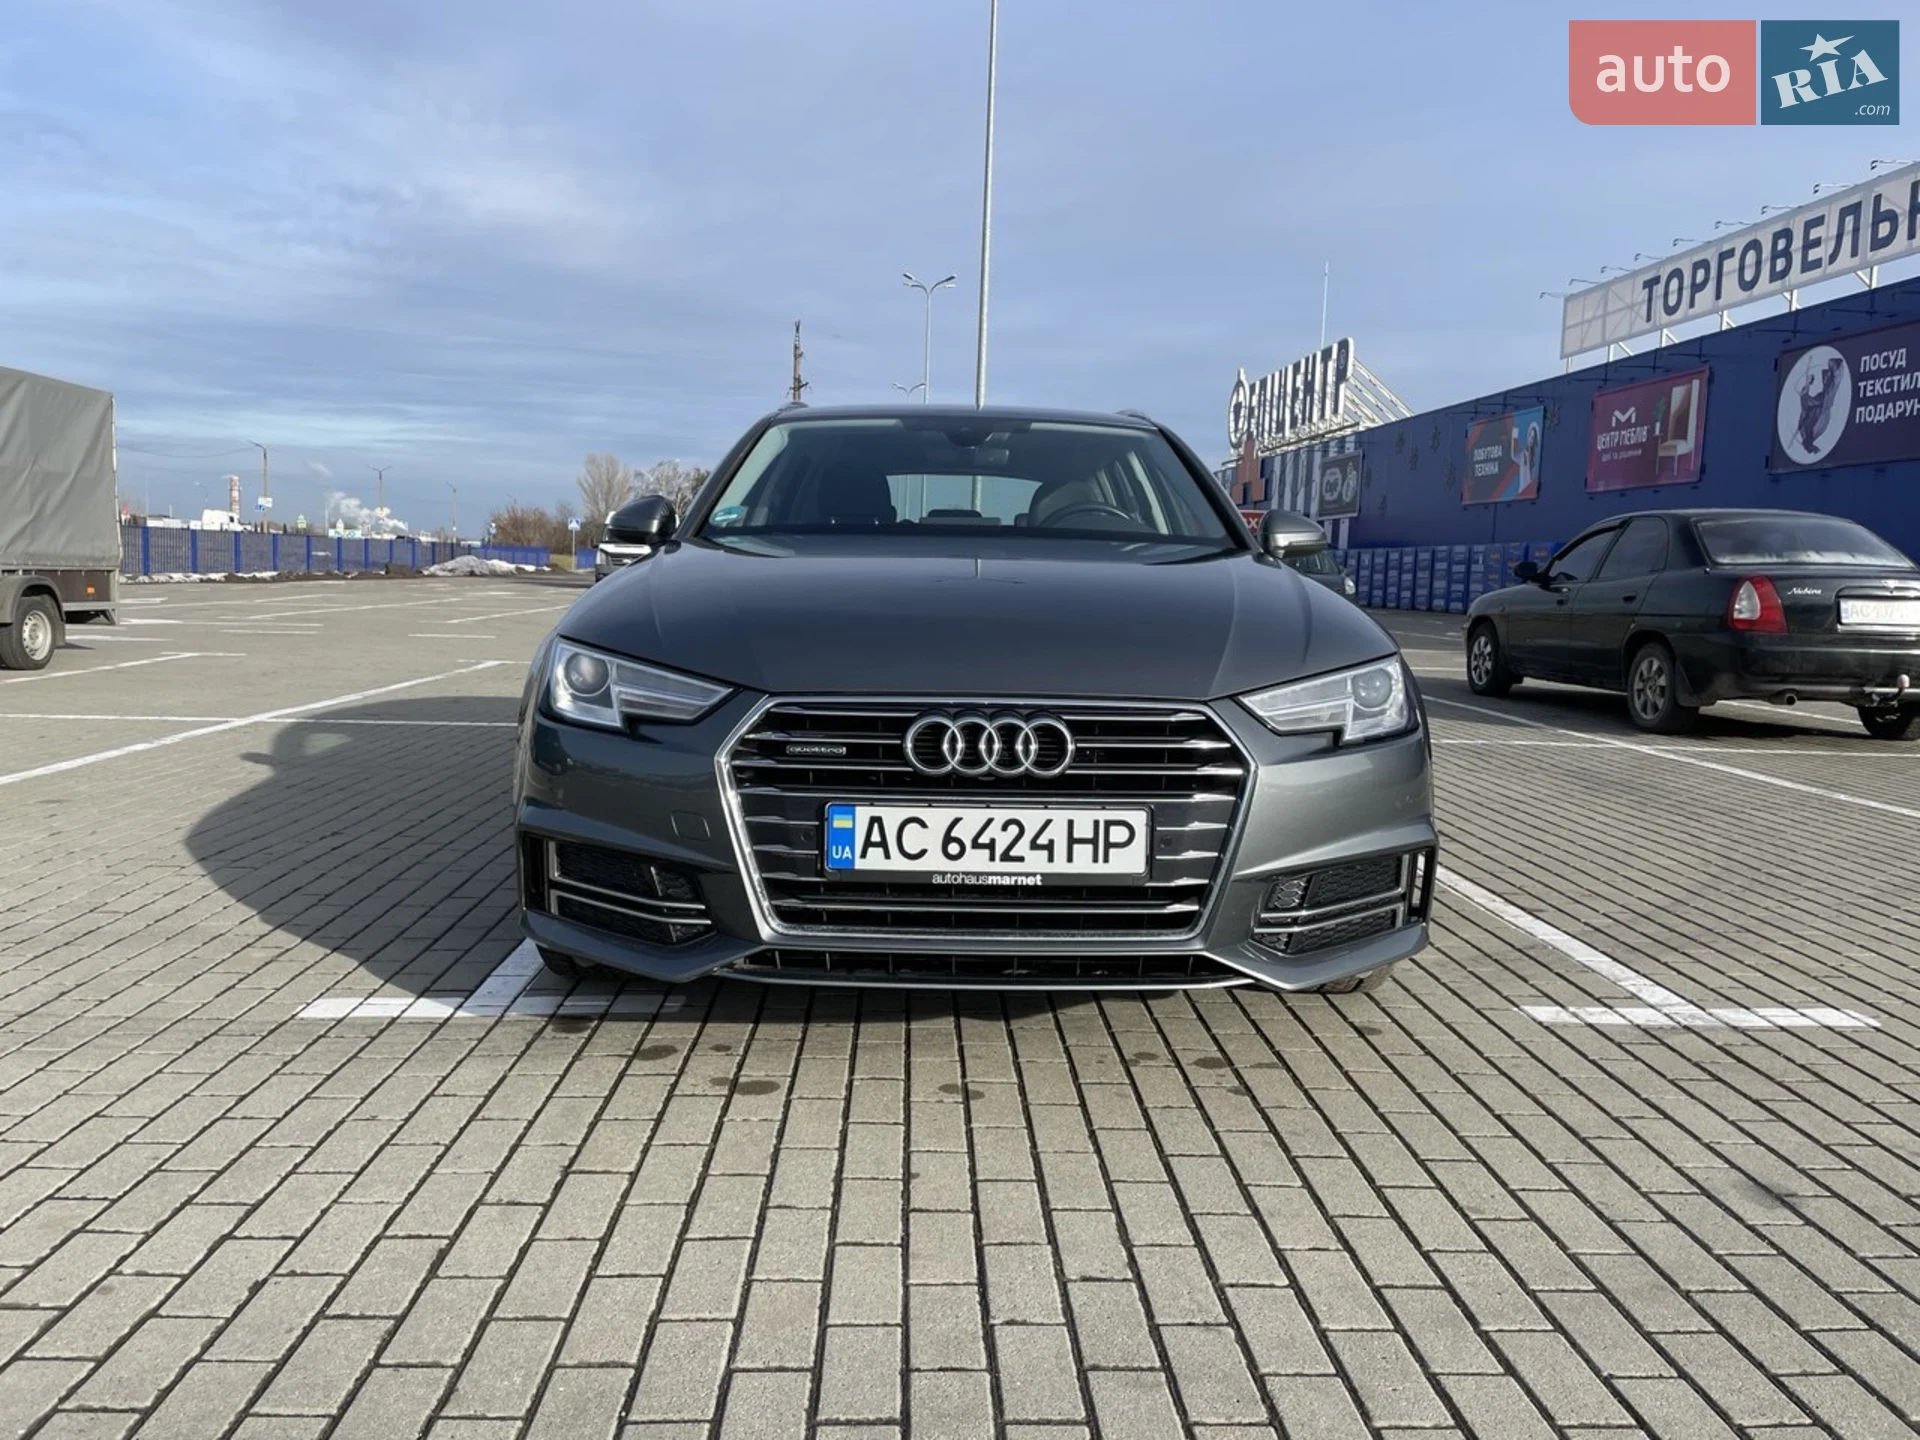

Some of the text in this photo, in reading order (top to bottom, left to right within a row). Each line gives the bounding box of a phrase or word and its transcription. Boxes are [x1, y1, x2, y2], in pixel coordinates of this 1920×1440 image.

[1860, 348, 1906, 373] ПОСУД
[1858, 371, 1920, 398] ТЕКСТИЛ
[787, 745, 844, 755] quattro
[832, 845, 853, 859] UA
[859, 815, 1137, 864] AC 6424 HP
